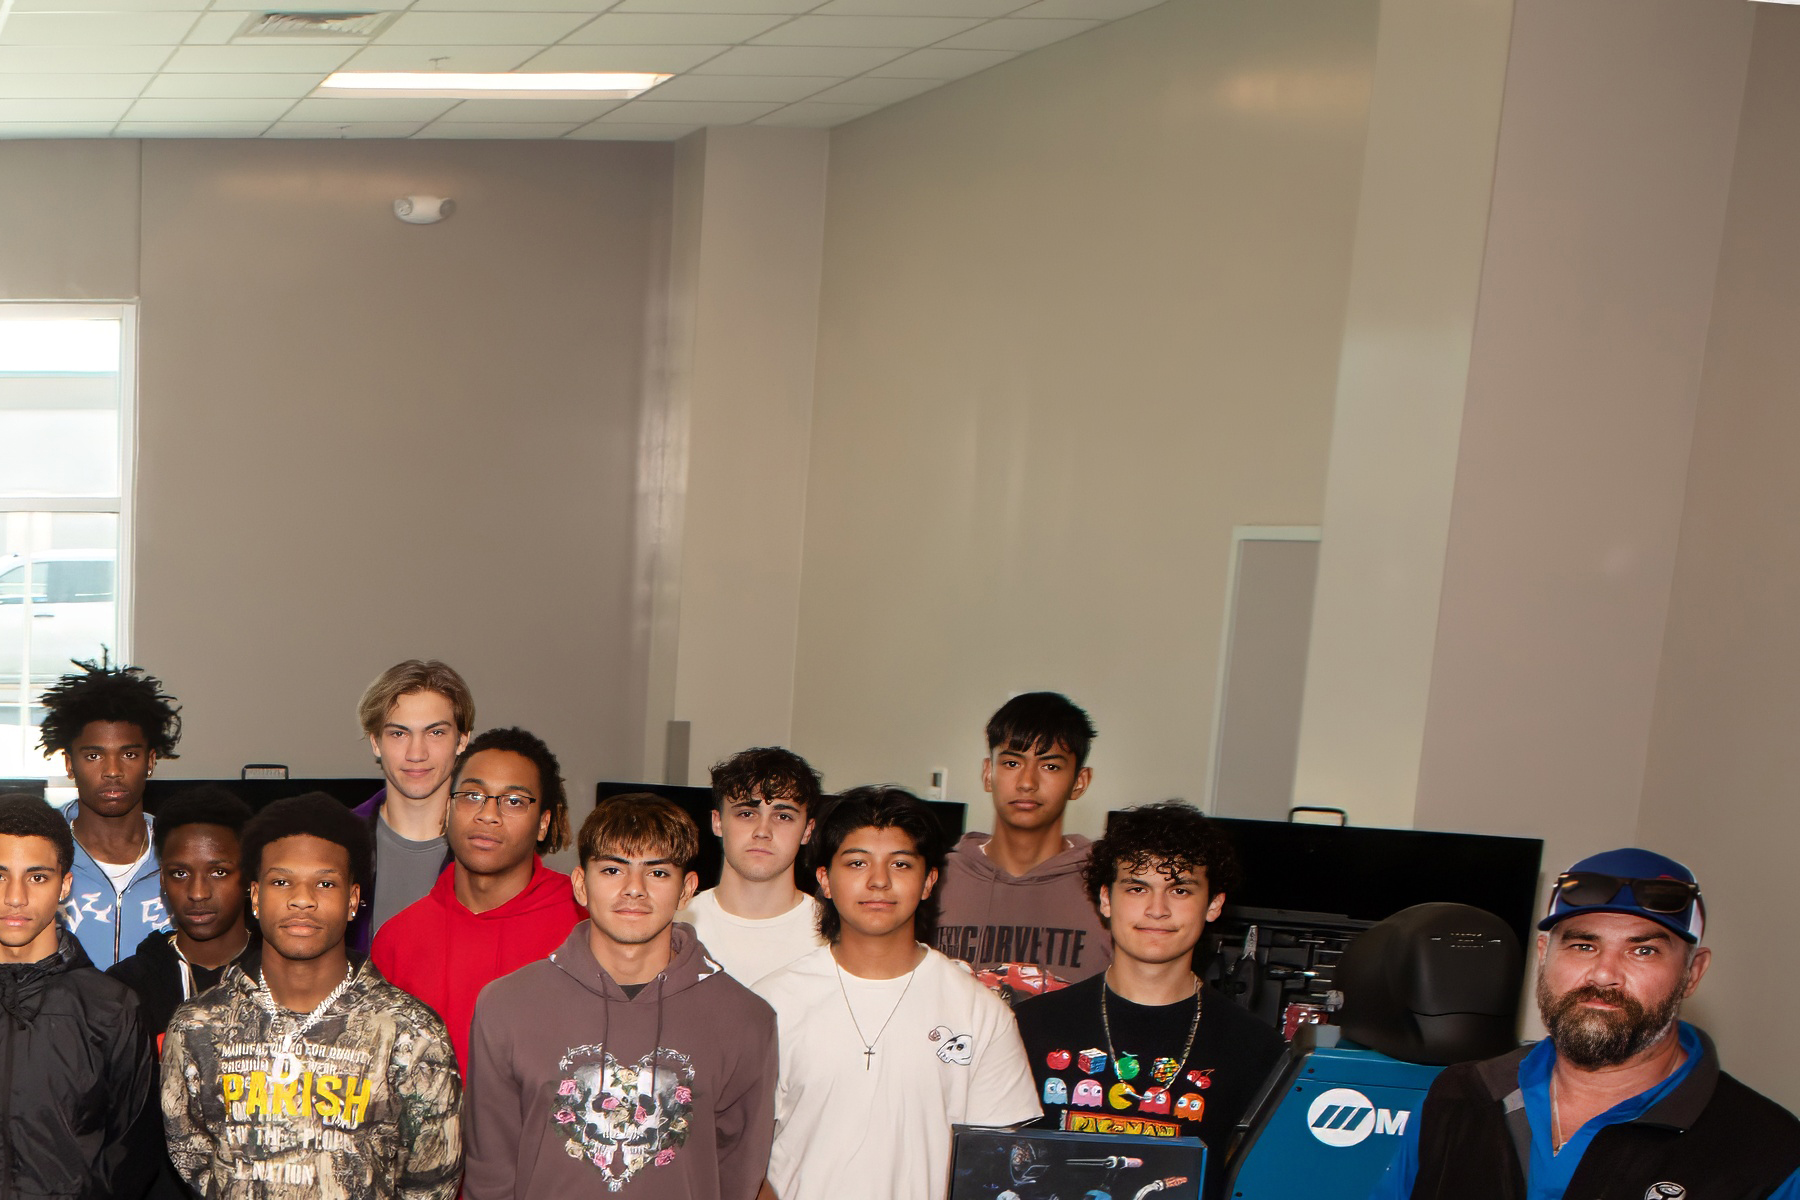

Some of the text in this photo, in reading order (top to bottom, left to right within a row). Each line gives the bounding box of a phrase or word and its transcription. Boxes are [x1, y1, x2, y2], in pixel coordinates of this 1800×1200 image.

[961, 926, 1087, 968] CORVETTE
[221, 1071, 372, 1122] PARISH
[253, 1160, 317, 1186] NATION
